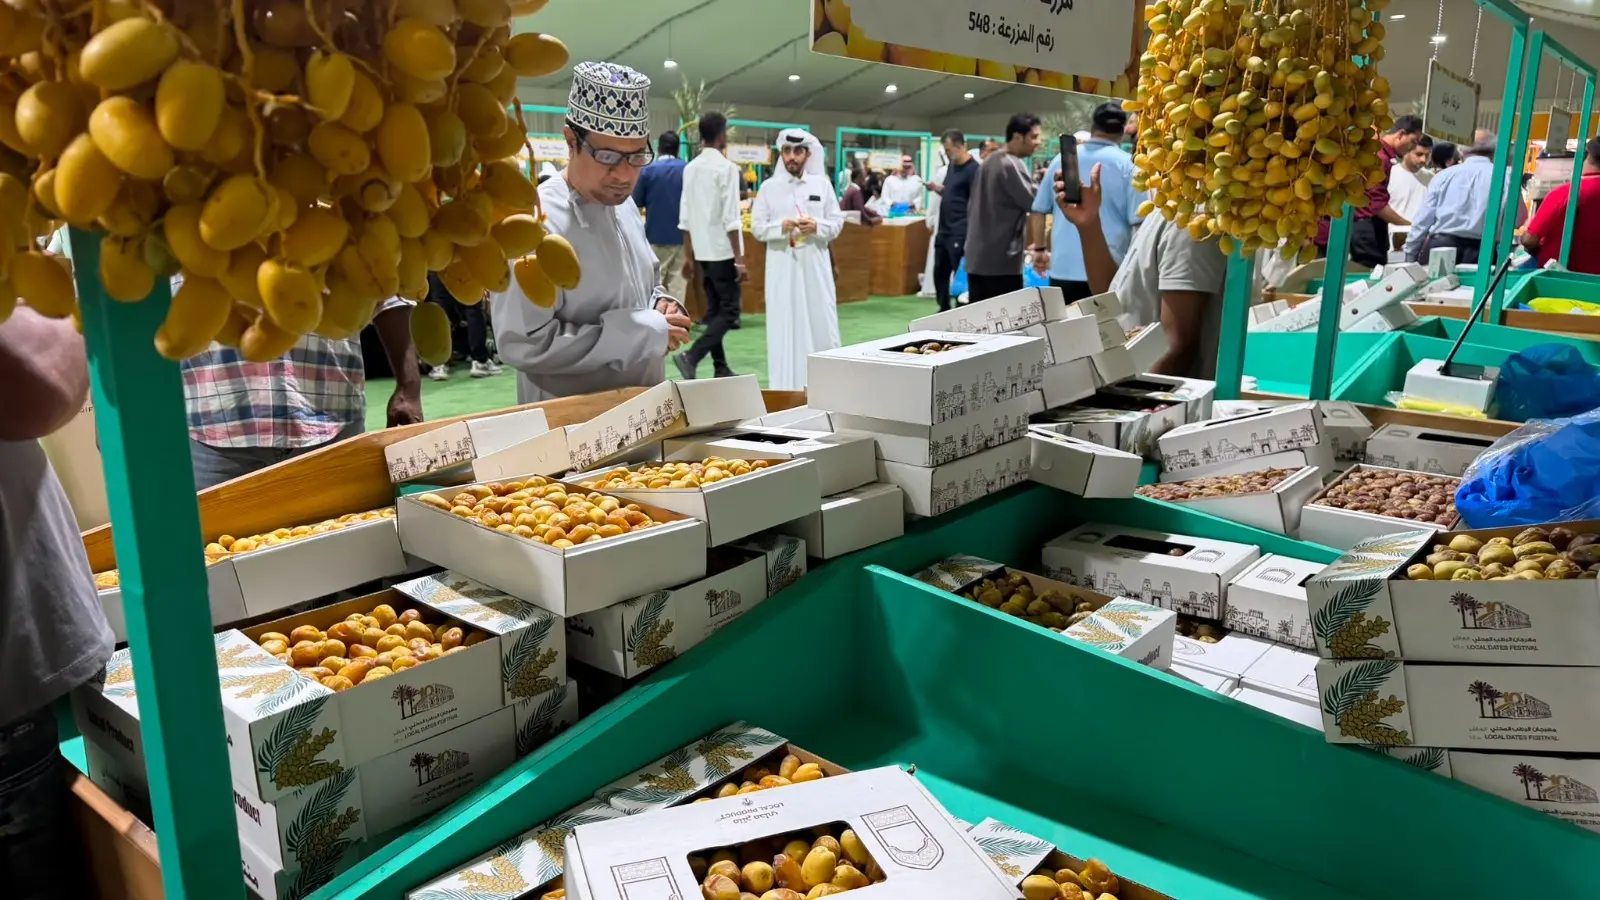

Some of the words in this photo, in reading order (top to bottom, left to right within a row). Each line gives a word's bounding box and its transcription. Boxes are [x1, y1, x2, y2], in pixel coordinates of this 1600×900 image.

[968, 11, 990, 33] 548
[1036, 28, 1055, 53] رقم
[1529, 734, 1559, 742] FESTIVAL
[233, 789, 262, 827] roduct
[758, 802, 785, 811] LOCAL
[720, 808, 758, 820] PRODUCT
[733, 815, 752, 824] منتج
[753, 811, 779, 820] محلي
